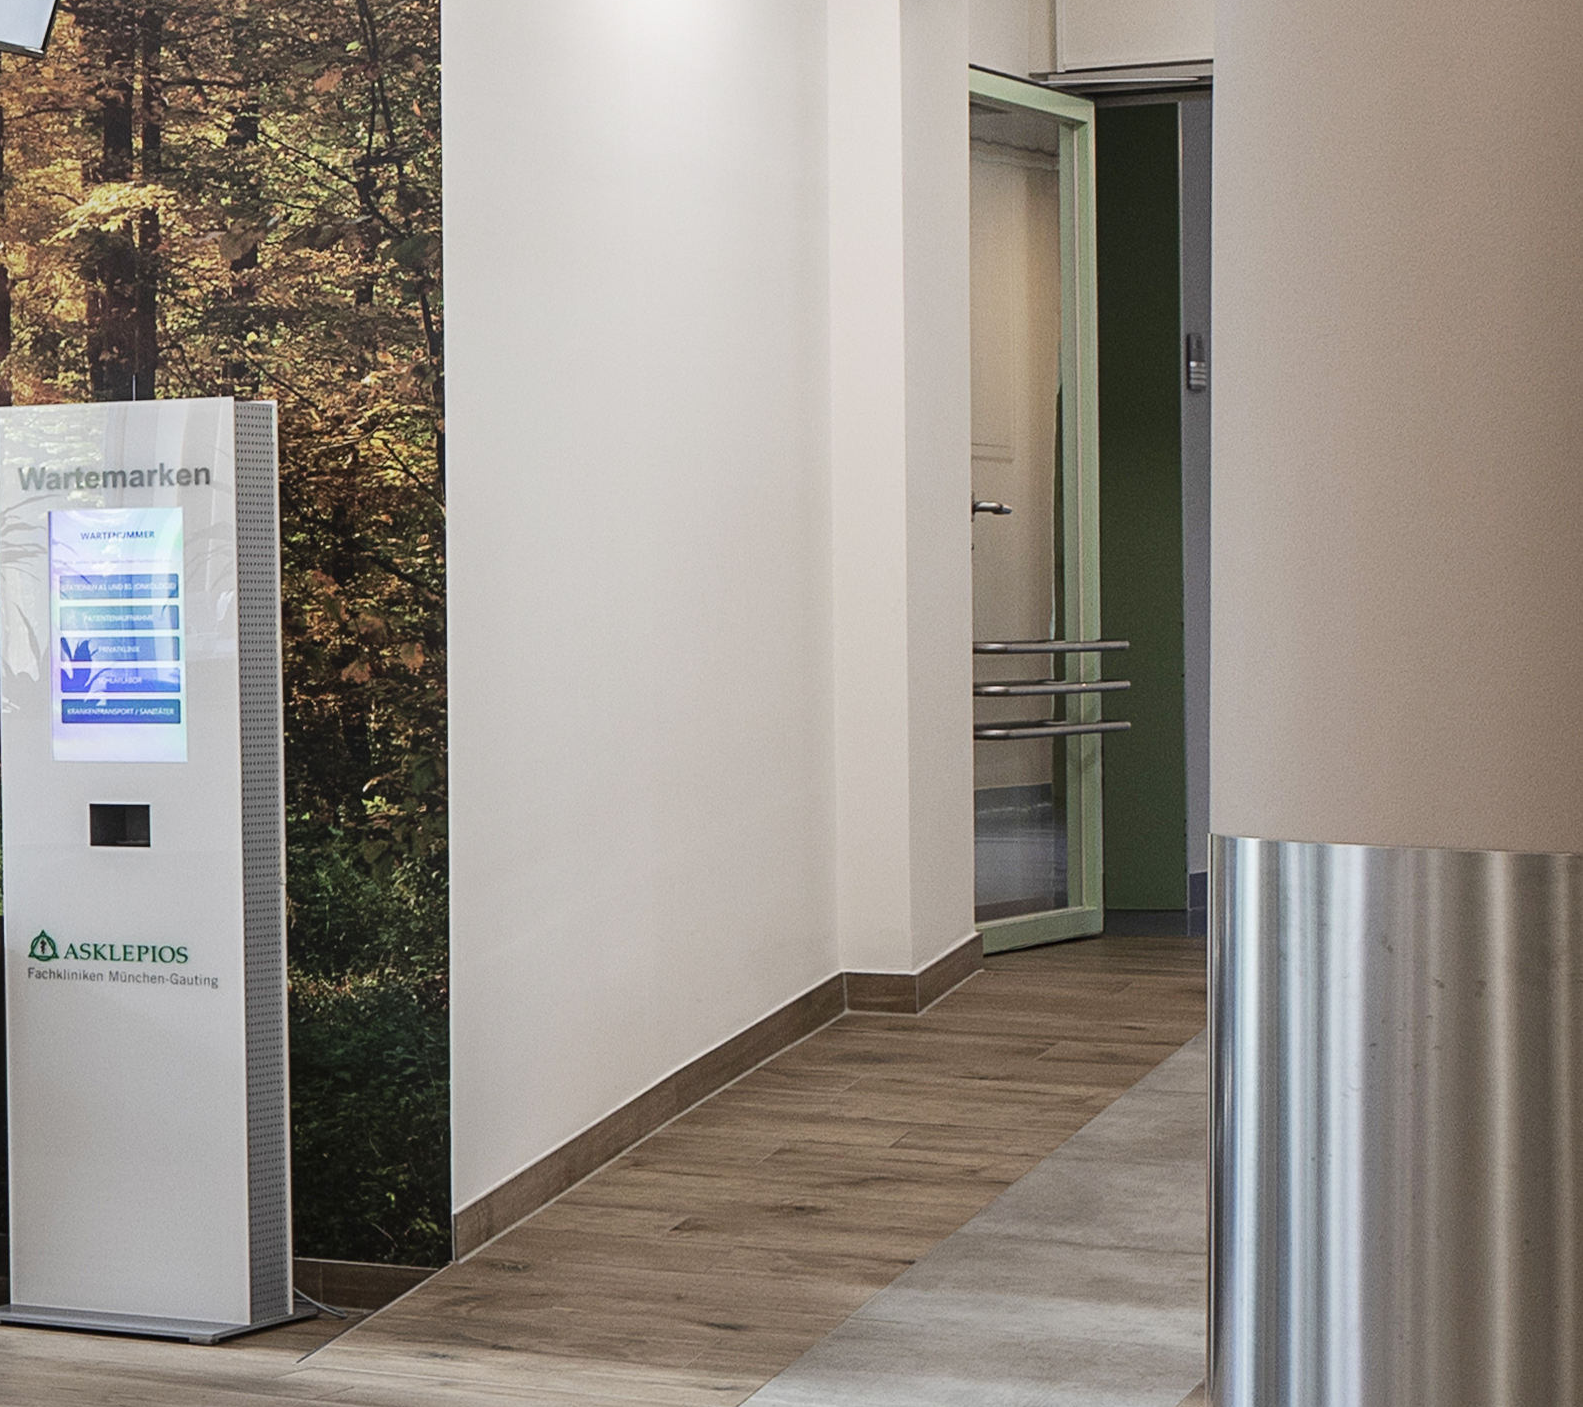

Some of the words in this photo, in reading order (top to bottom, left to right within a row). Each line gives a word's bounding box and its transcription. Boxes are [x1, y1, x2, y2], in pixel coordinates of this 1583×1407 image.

[18, 462, 211, 491] Wartemarken
[80, 531, 155, 540] WARTENUMMER
[66, 707, 134, 716] KRANKENTRANSPORT
[63, 942, 189, 964] ASKLEPIOS
[27, 967, 104, 982] Fachkliniken
[108, 971, 219, 989] München-Gauting
